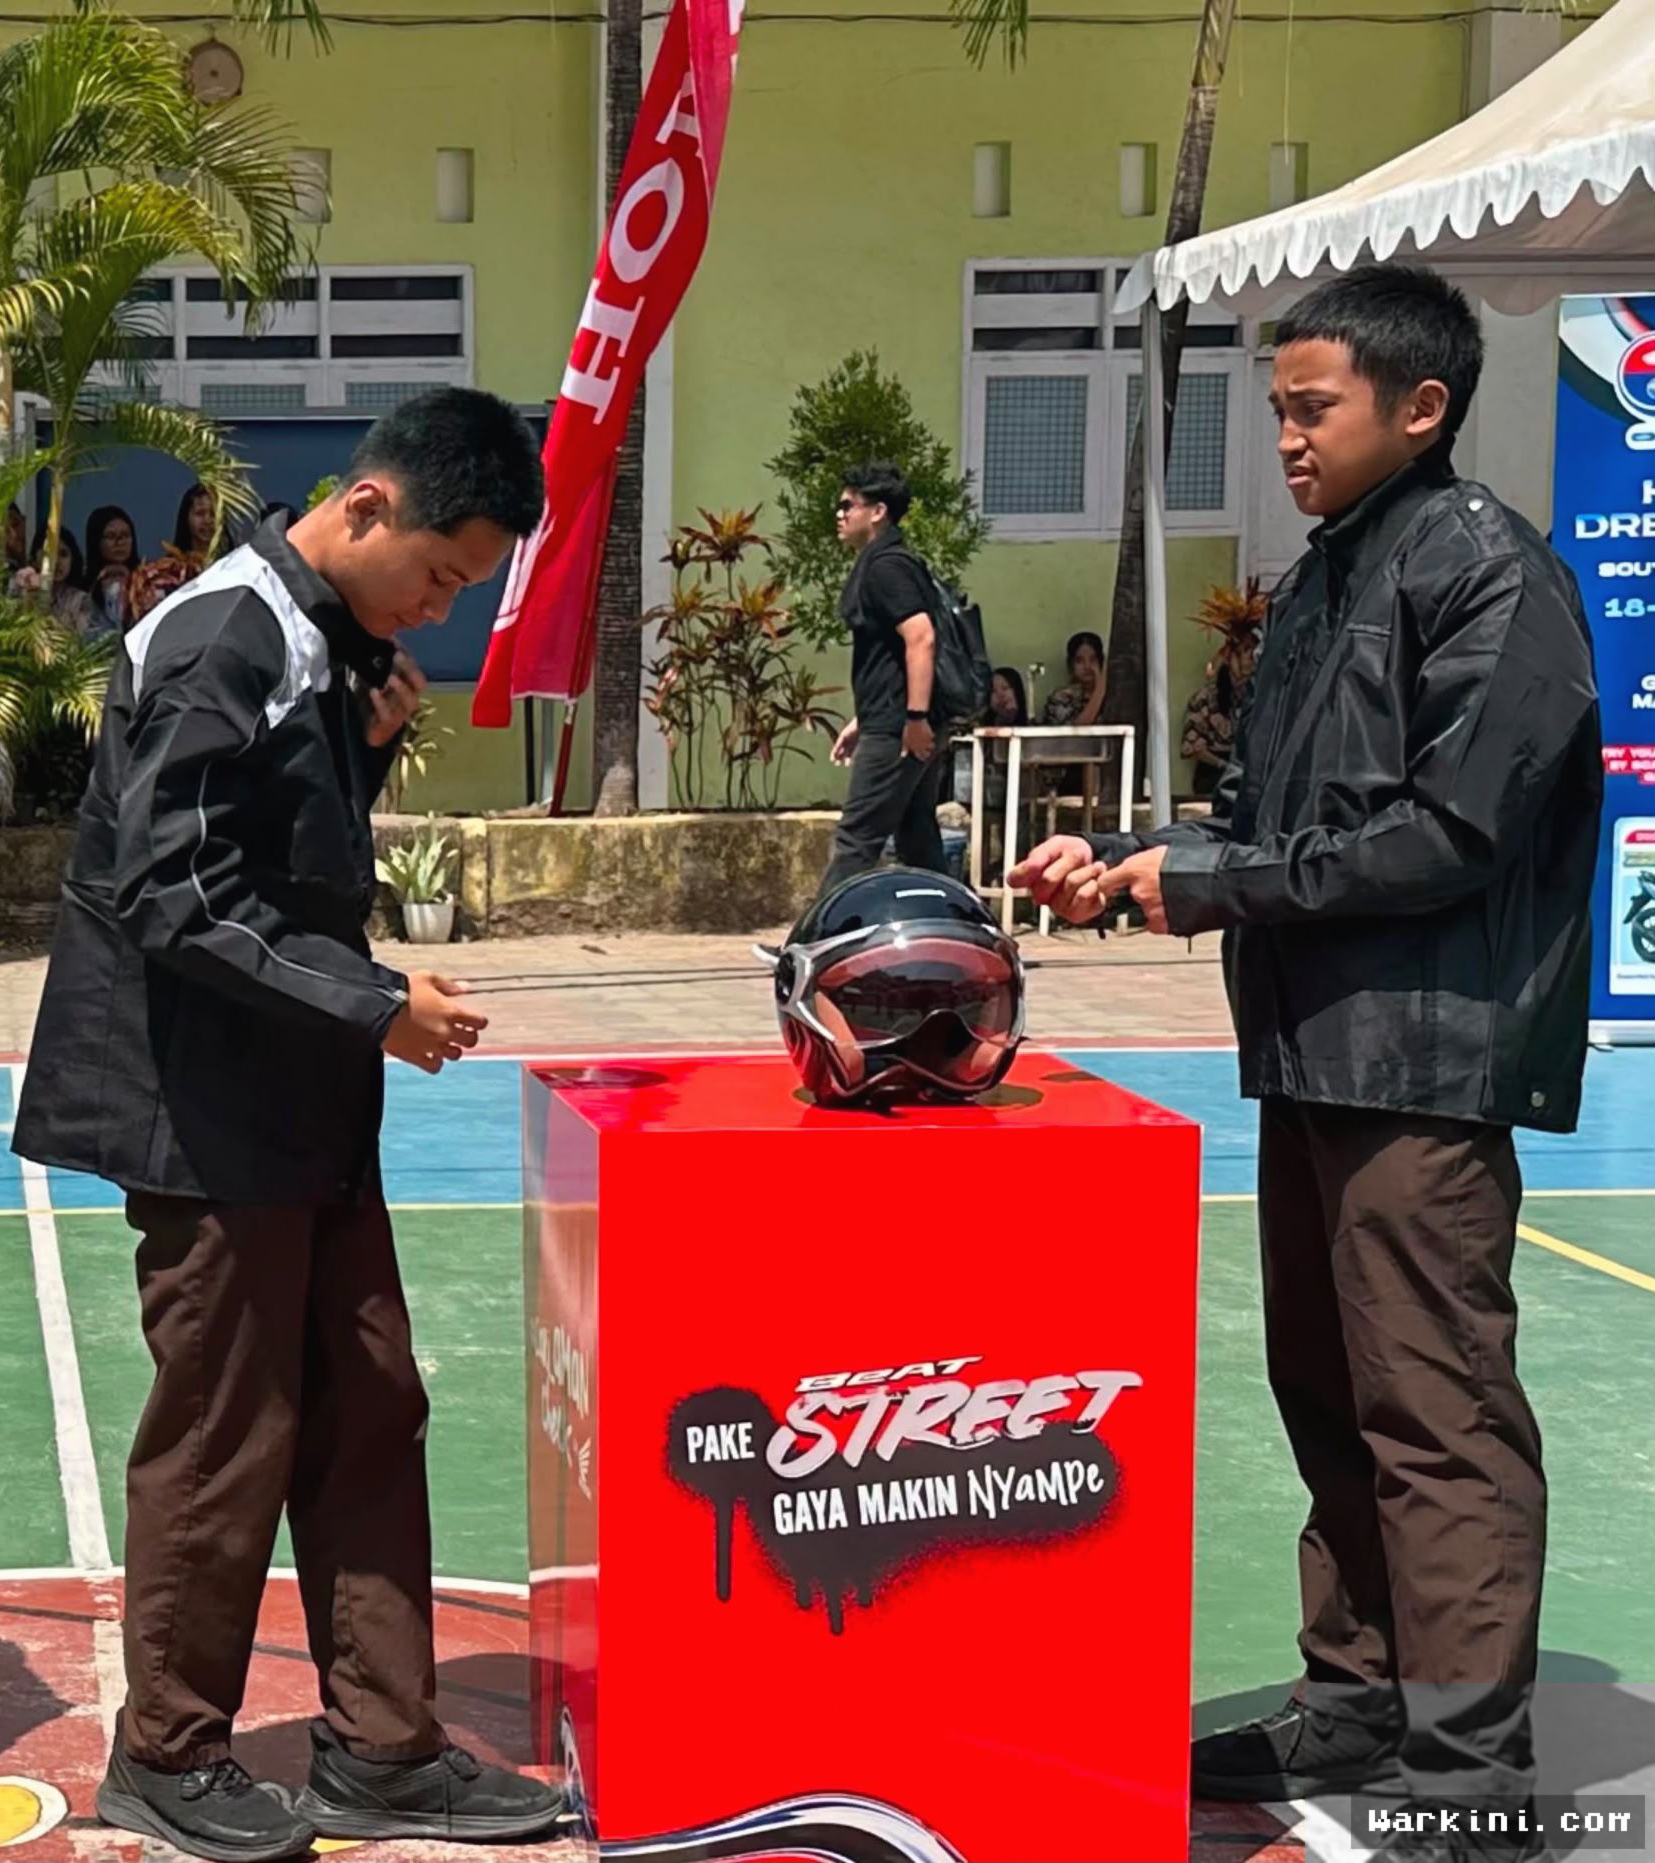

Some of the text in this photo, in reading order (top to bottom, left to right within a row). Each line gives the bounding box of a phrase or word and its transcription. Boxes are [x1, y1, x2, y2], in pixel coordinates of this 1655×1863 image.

[687, 1371, 1143, 1478] PAKE STREET
[773, 1487, 848, 1535] GAYA
[858, 1474, 959, 1526] MAKIN
